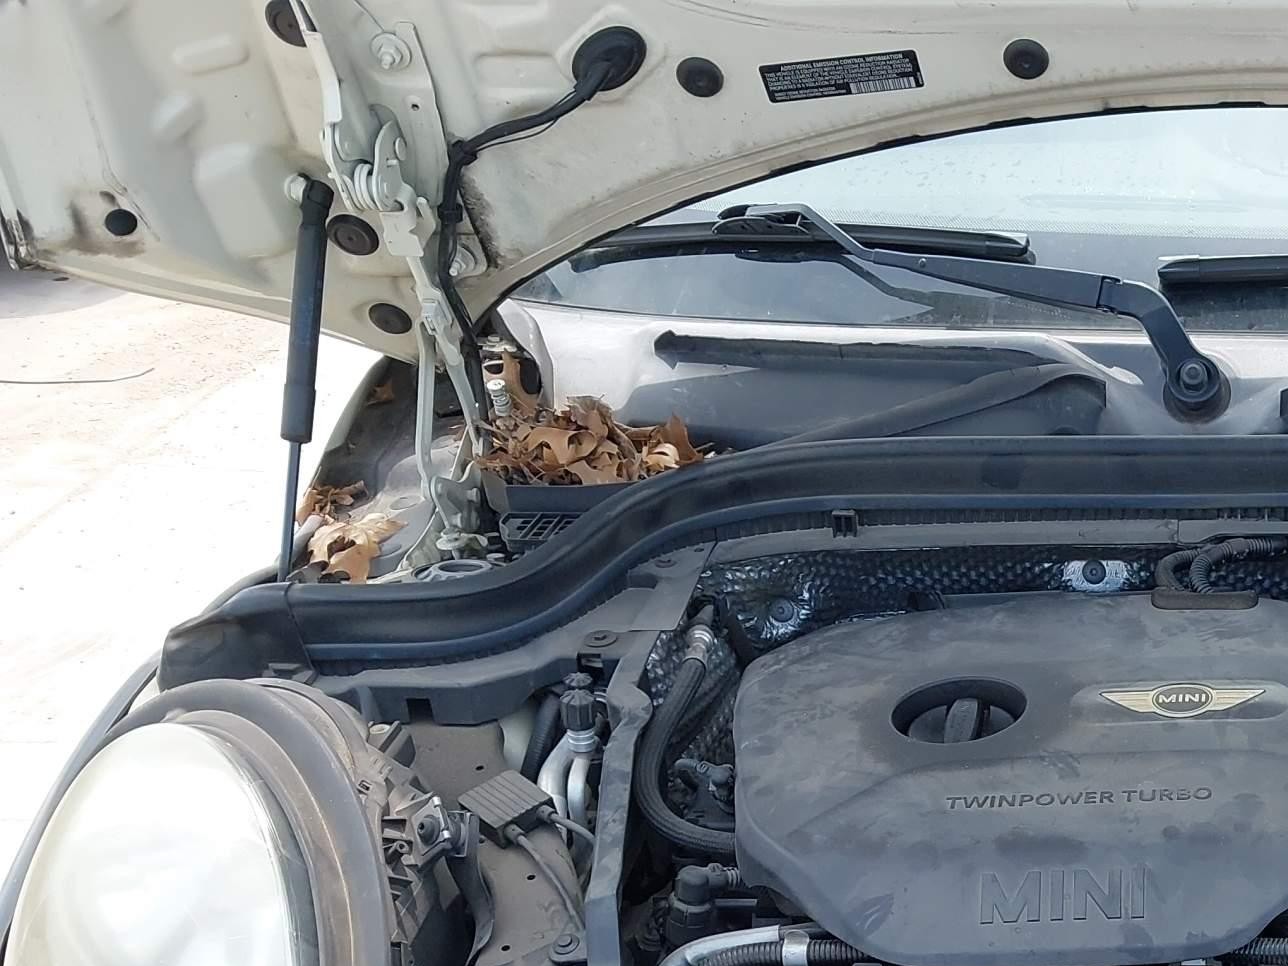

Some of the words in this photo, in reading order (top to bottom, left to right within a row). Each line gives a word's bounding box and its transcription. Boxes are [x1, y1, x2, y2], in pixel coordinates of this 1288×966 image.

[865, 53, 902, 62] INFORMATION
[1158, 693, 1207, 703] MINI
[946, 791, 1115, 810] TWINPOWER
[1122, 786, 1212, 803] TURBO
[980, 869, 1146, 925] MINI
